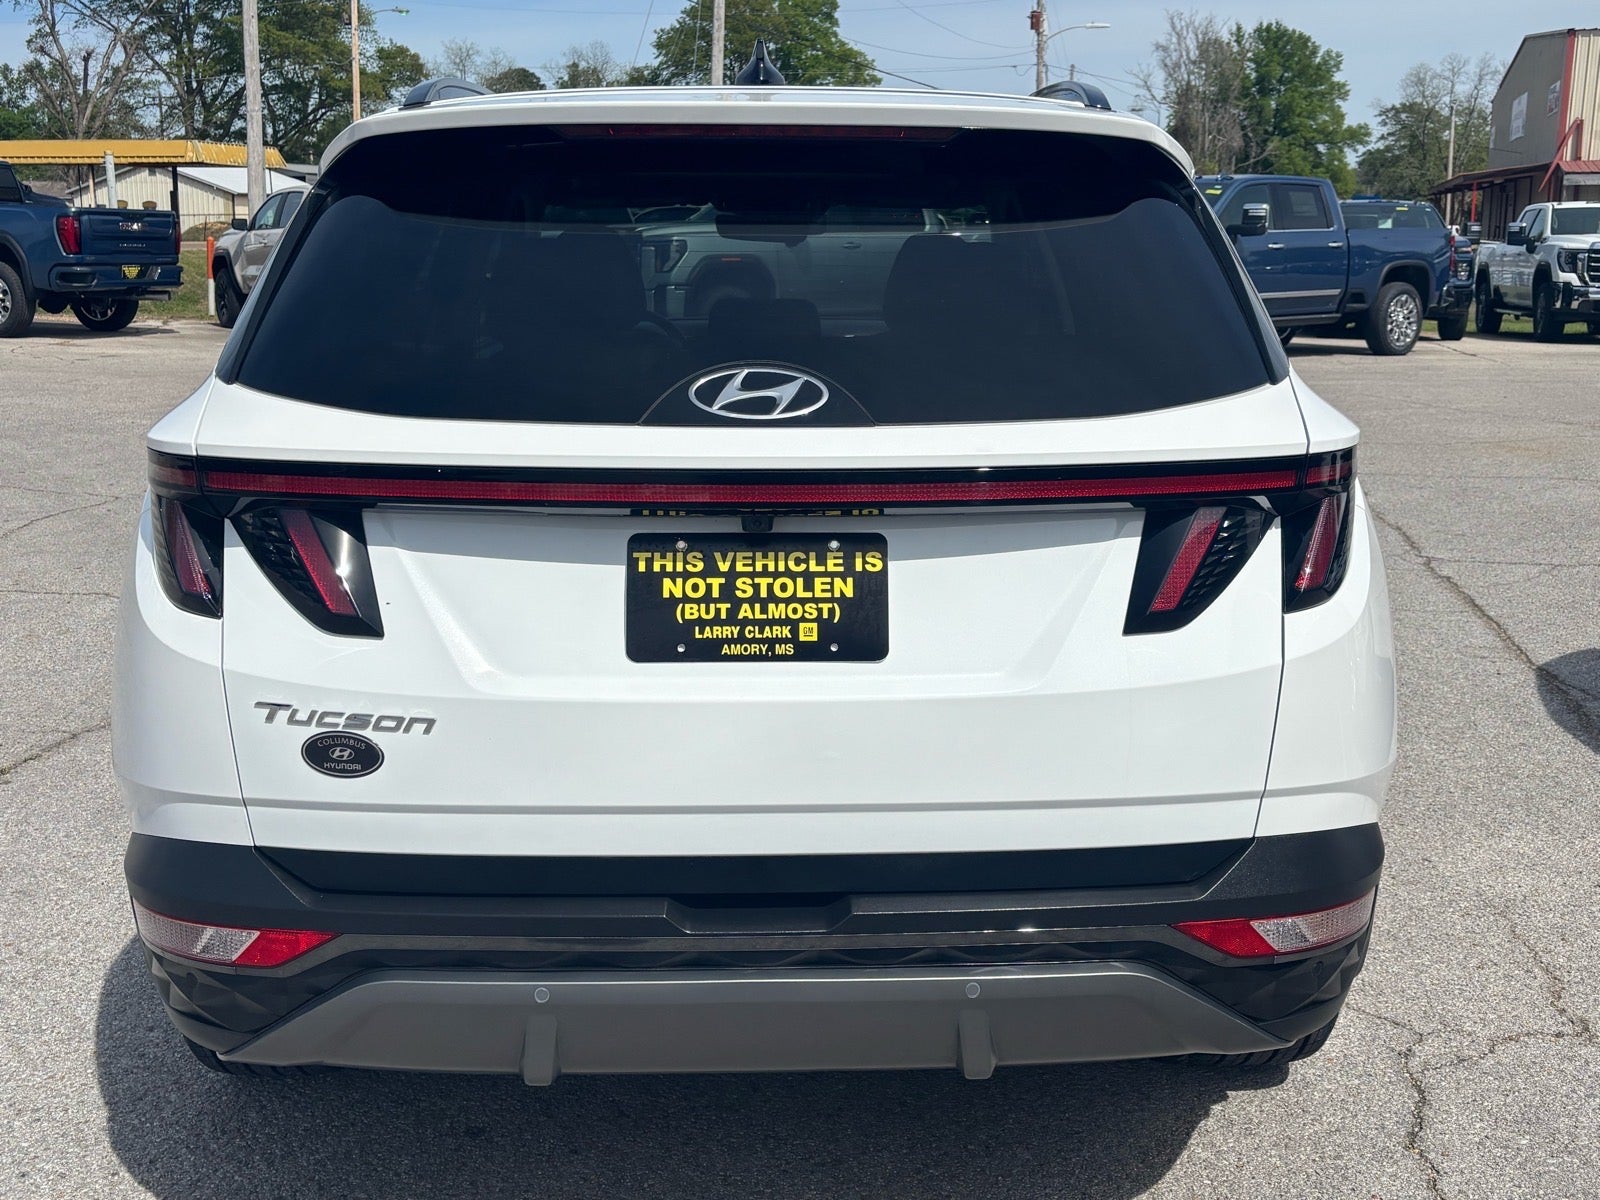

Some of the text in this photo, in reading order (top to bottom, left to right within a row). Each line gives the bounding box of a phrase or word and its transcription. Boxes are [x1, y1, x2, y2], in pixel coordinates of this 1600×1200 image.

[632, 551, 884, 573] THIS VEHICLE IS
[662, 577, 854, 599] NOT STOLEN
[675, 603, 841, 624] (BUT ALMOST)
[694, 626, 740, 639] LARRY
[744, 626, 792, 639] CLARK
[721, 643, 795, 657] AMORY, MS
[316, 737, 367, 750] COLUMBUS
[323, 761, 362, 771] HYUNDAI
